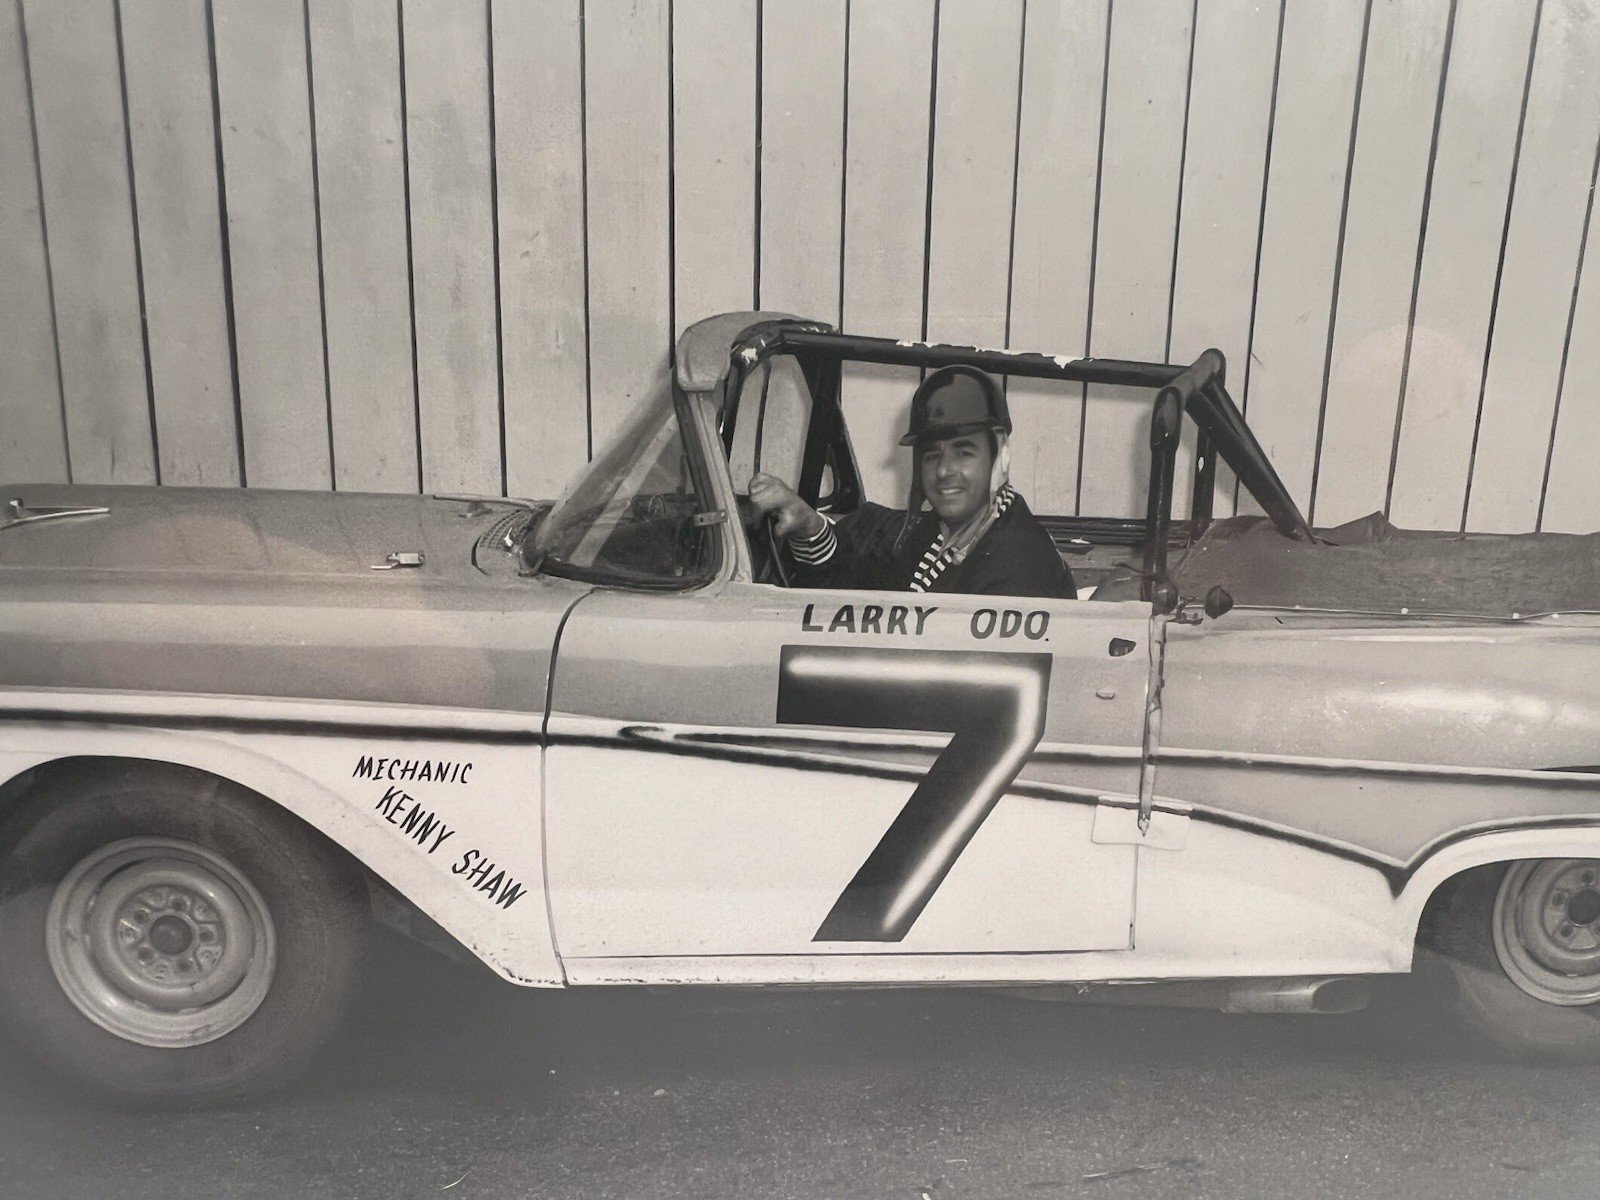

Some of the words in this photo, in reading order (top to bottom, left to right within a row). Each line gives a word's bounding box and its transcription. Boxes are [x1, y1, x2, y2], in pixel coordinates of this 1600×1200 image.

[801, 604, 938, 636] LARRY
[352, 755, 473, 784] MECHANIC
[776, 644, 1053, 942] 7
[375, 785, 455, 854] KENNY
[451, 849, 528, 910] SHAW
